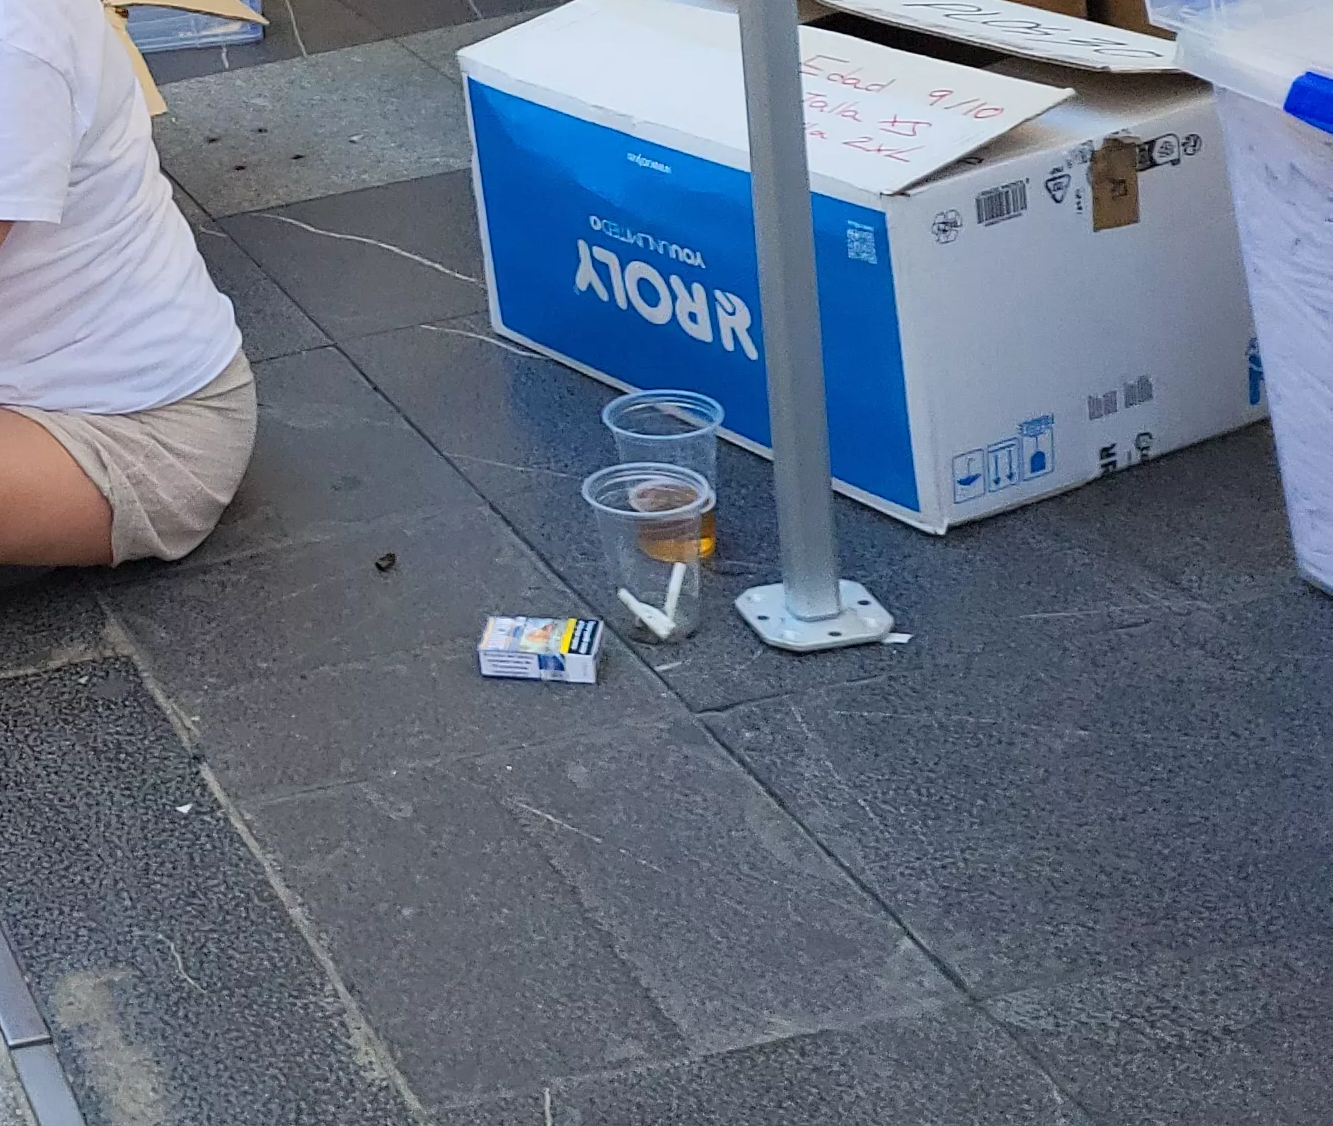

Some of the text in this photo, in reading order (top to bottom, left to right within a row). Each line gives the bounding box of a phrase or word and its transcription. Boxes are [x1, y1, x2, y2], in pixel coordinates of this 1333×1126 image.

[802, 54, 1005, 120] Edad 9/10
[805, 91, 863, 124] Talla
[575, 238, 714, 343] ROLY
